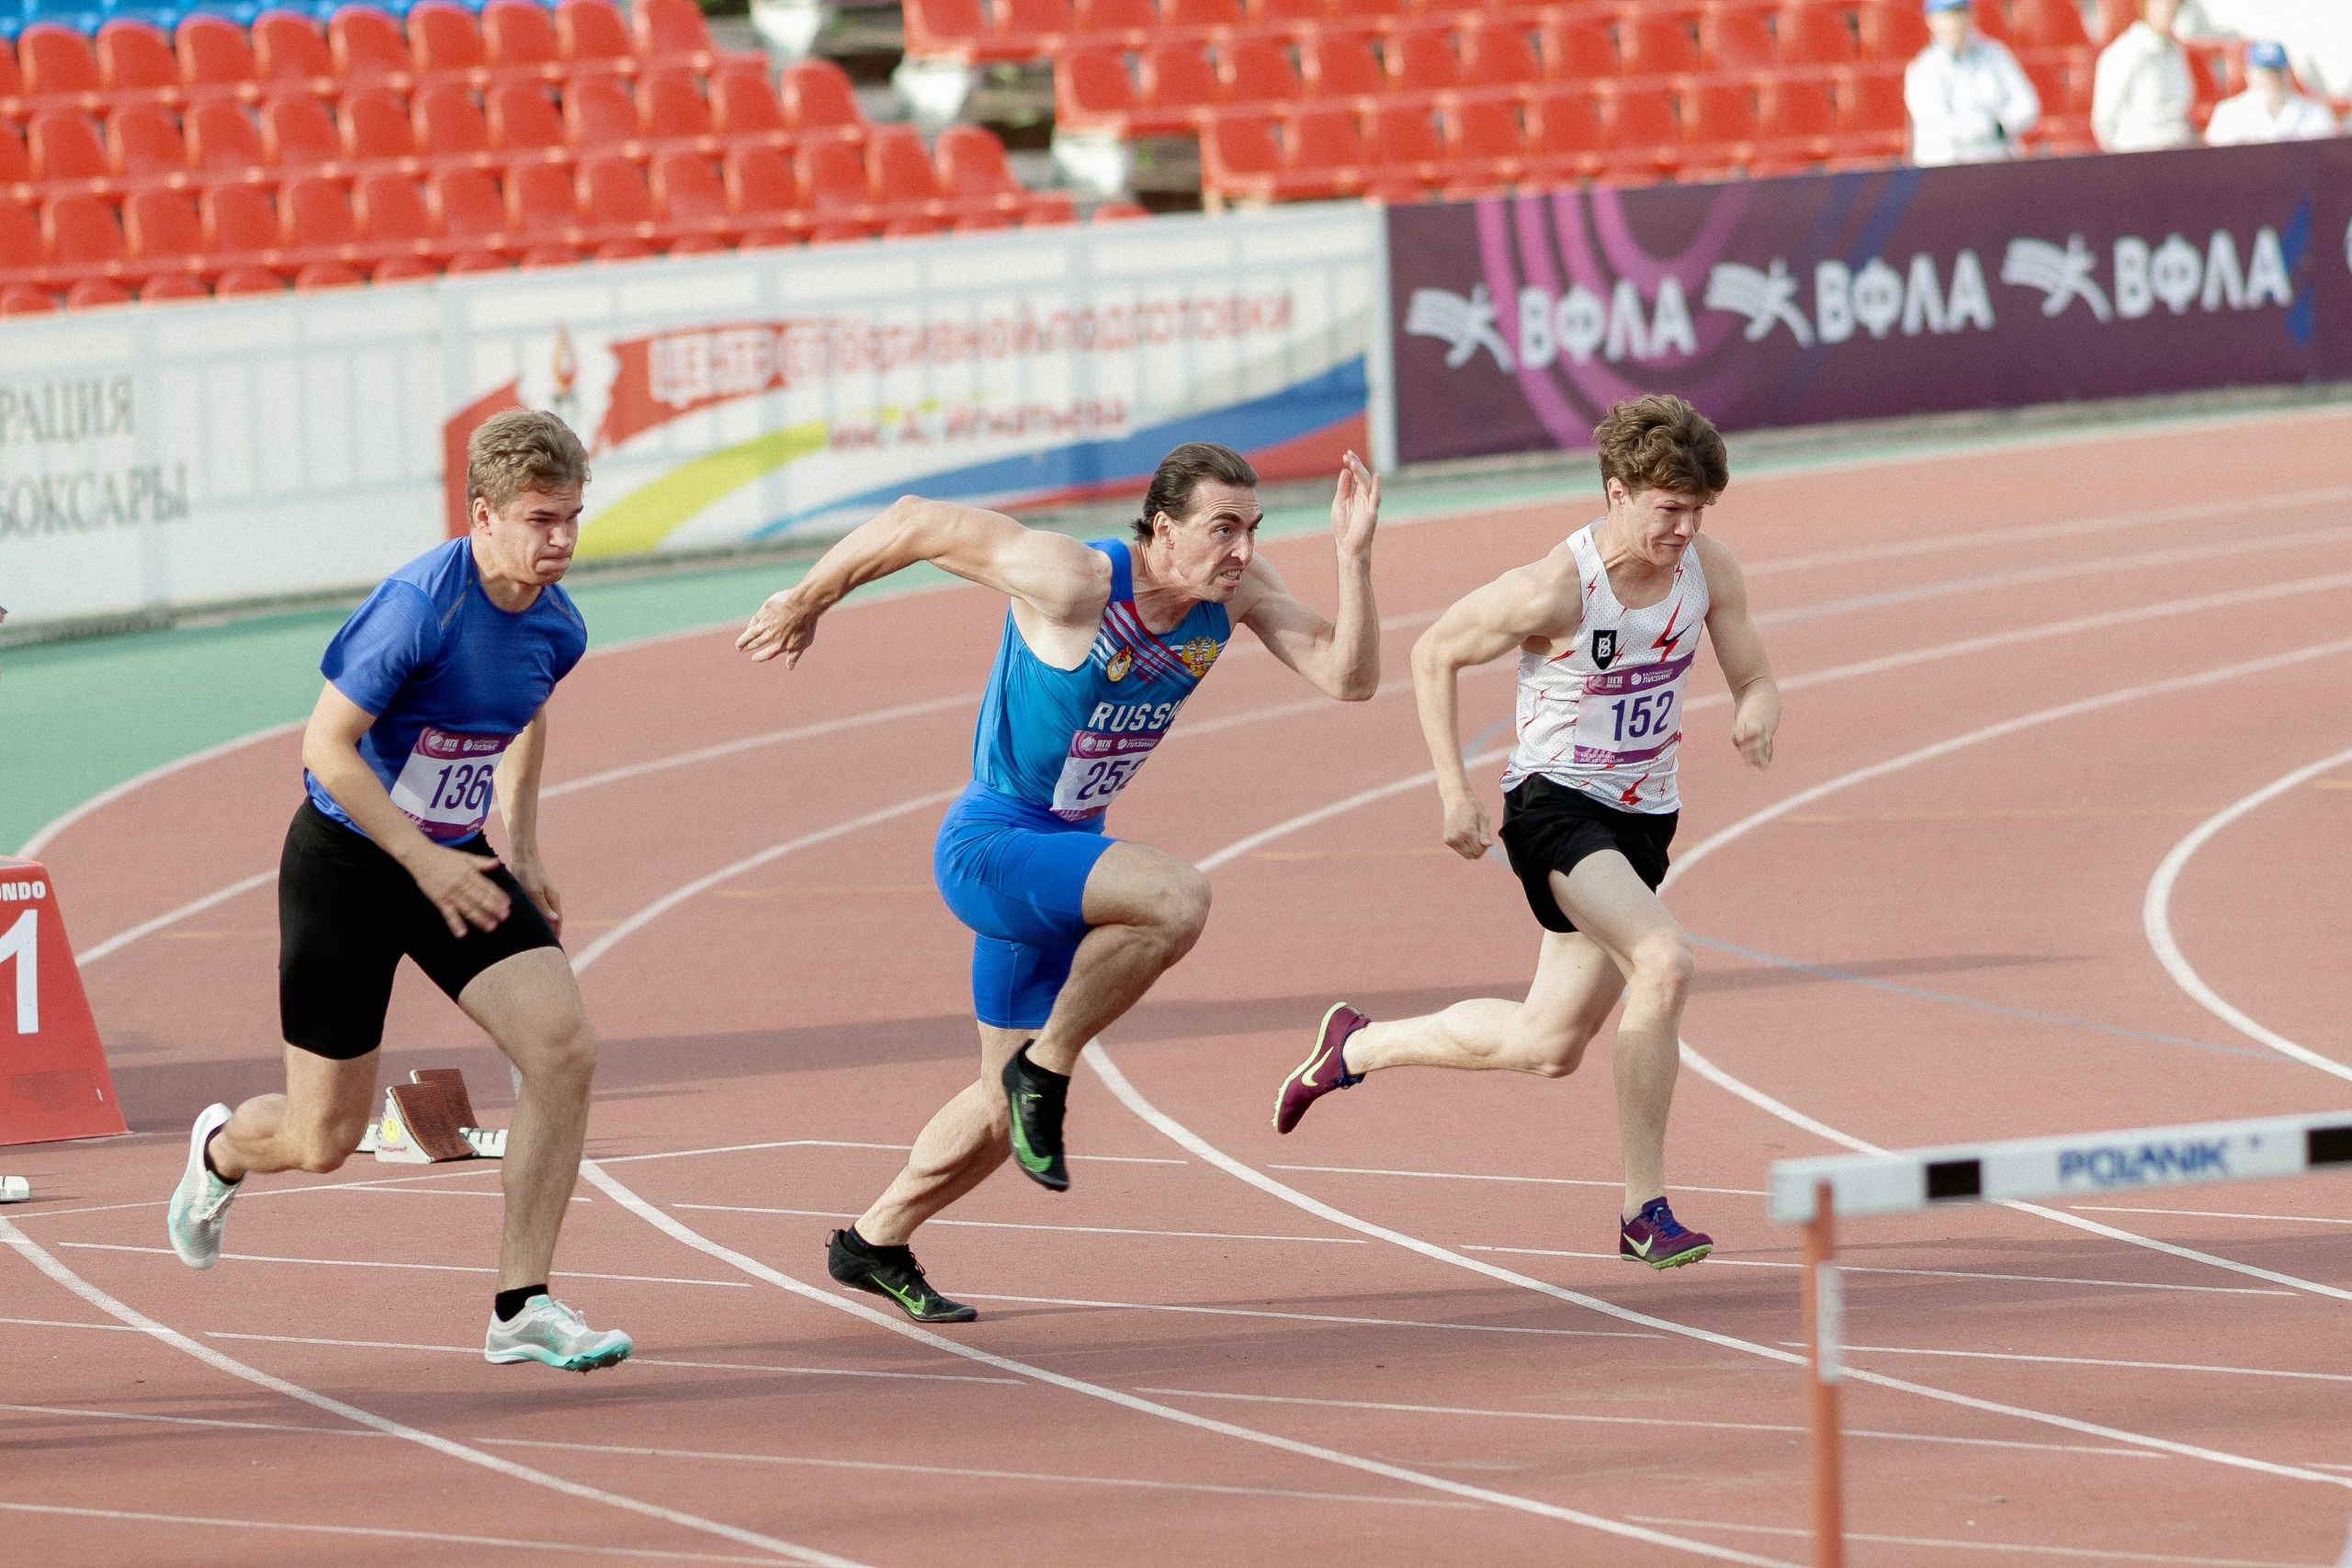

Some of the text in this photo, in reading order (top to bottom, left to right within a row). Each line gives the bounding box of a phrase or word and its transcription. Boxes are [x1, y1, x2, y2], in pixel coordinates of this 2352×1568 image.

[1814, 248, 1996, 344] ВФЛА
[2113, 224, 2294, 320] ВФЛА
[1047, 293, 1294, 353] ПОДГОТОВКИ
[1519, 275, 1697, 369] ВФЛА
[1642, 672, 1672, 683] ЛИЗИНГ
[1611, 691, 1674, 741] 152
[429, 764, 493, 809] 136
[0, 880, 46, 902] NDO
[0, 908, 39, 1034] 1
[2057, 1136, 2231, 1186] POLANIK
